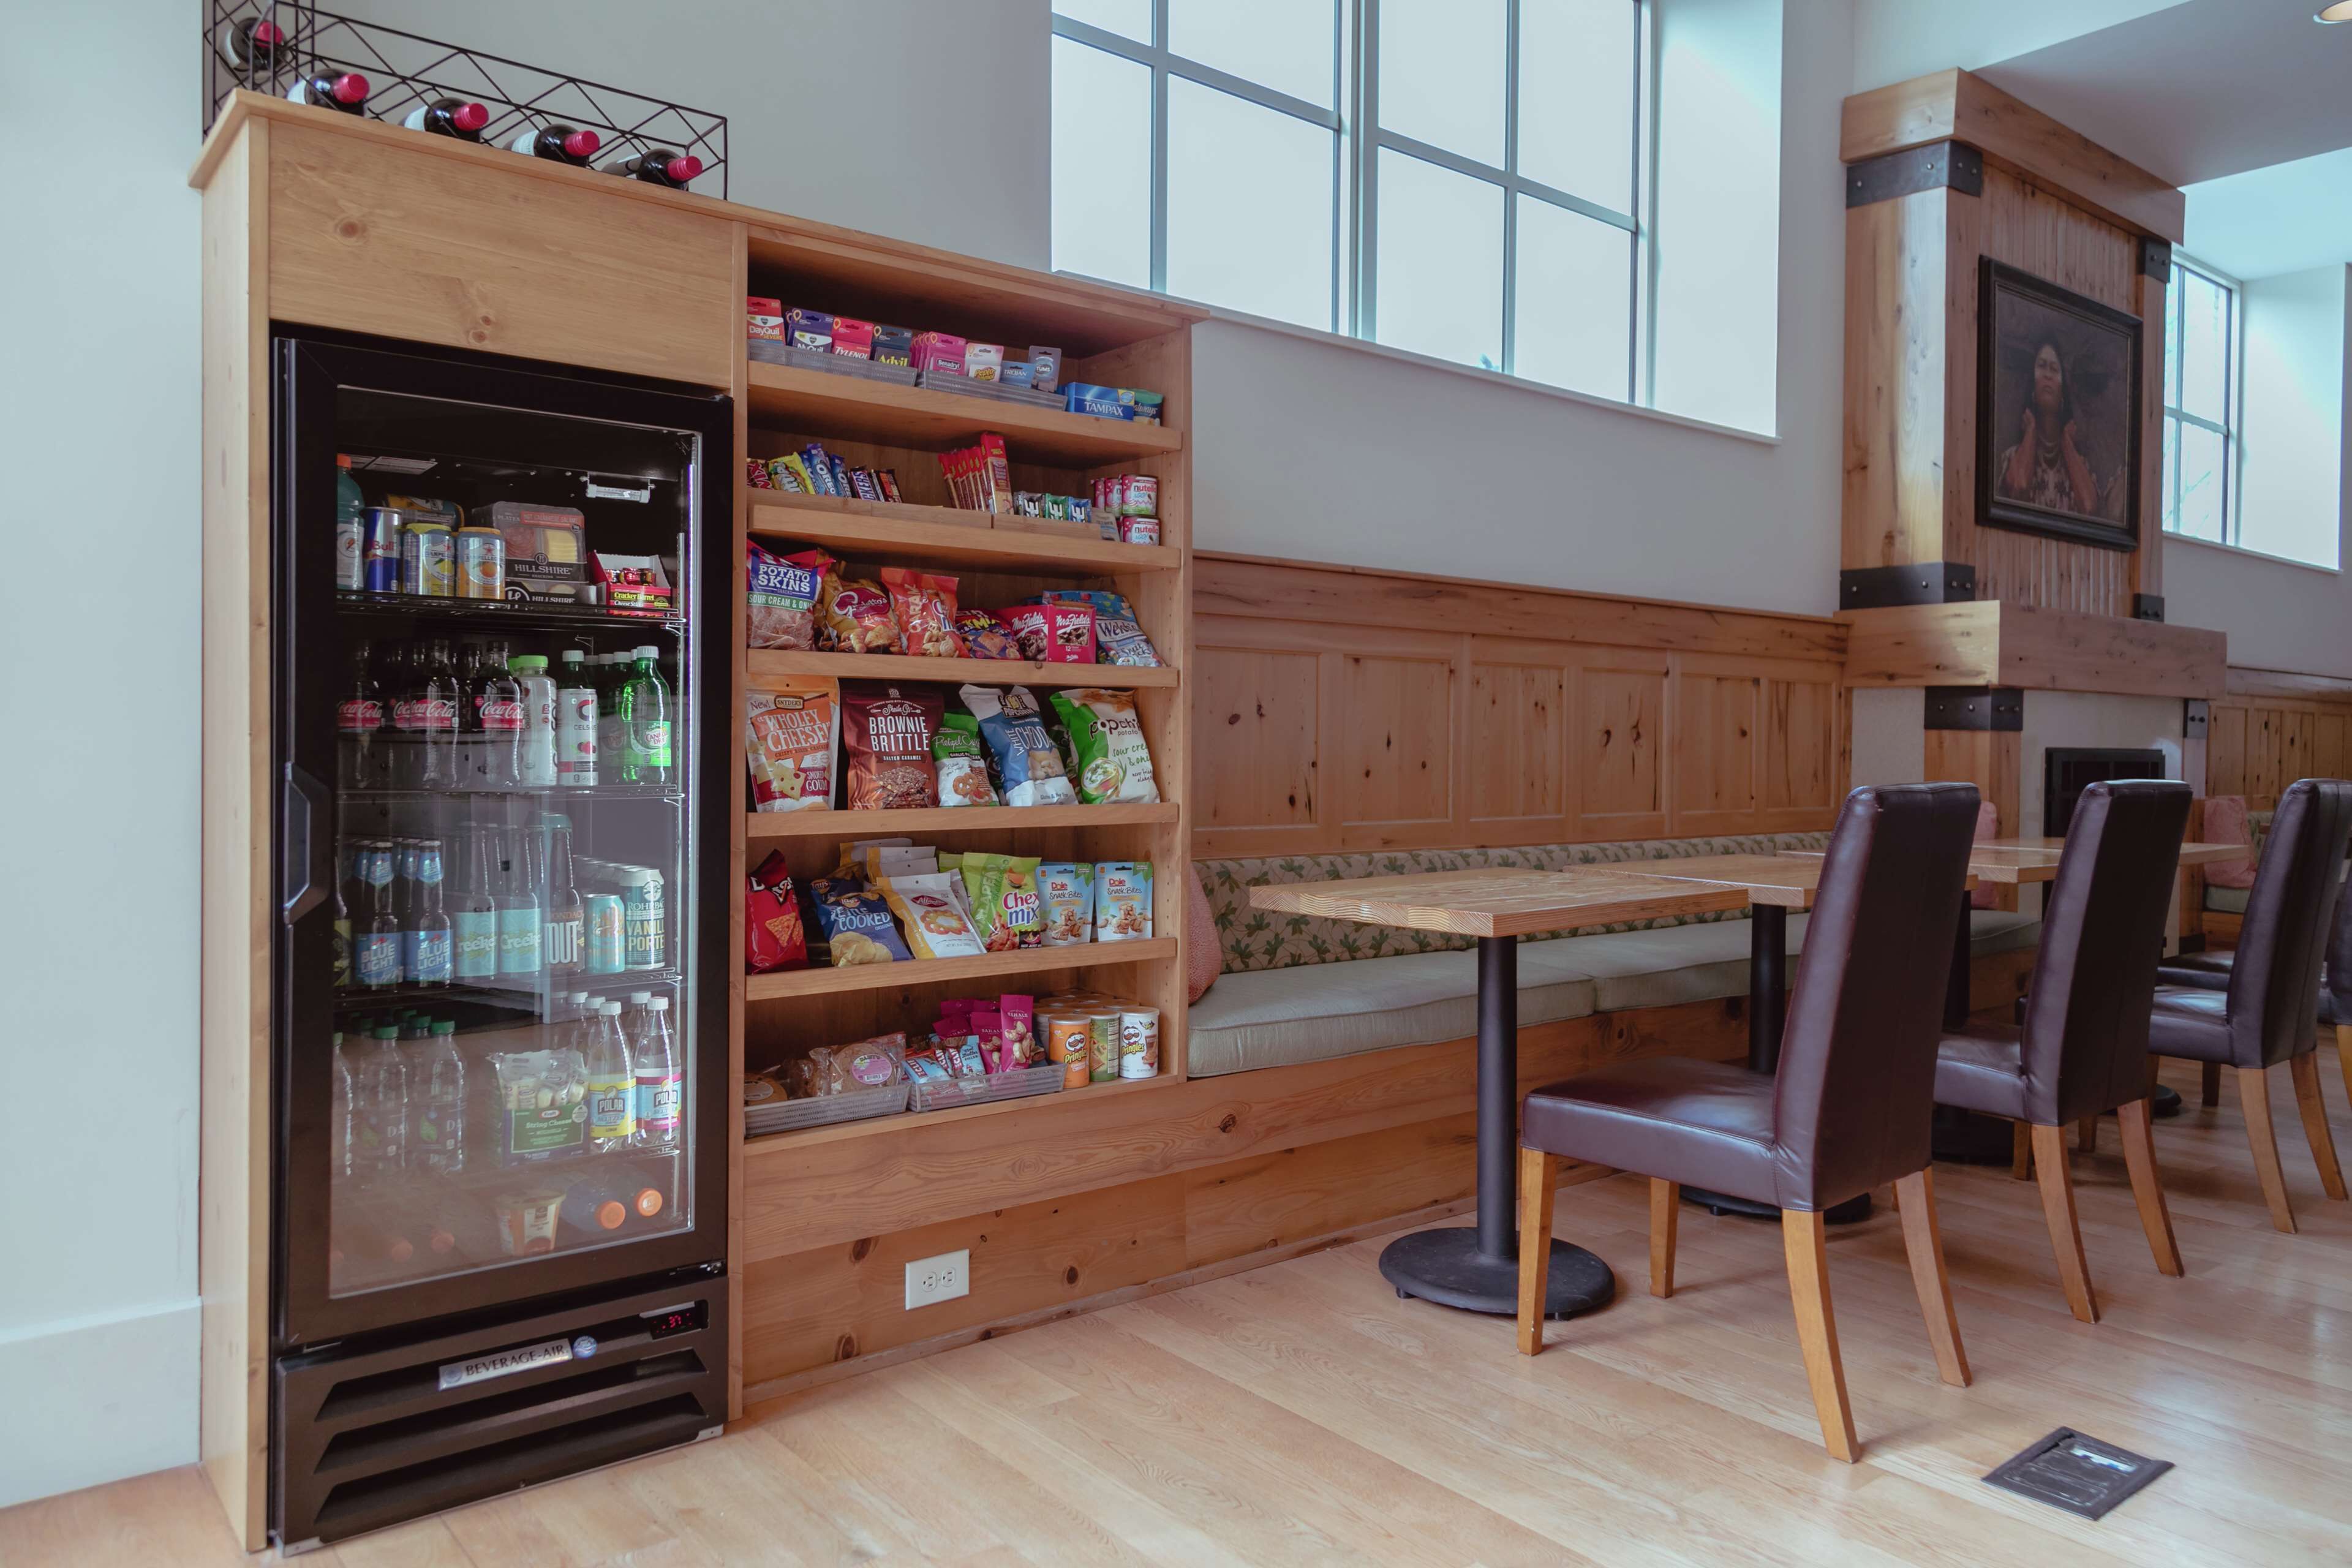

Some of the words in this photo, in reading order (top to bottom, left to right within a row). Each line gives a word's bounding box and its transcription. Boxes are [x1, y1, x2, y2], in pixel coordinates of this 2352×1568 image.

[749, 326, 780, 336] DayQuil
[835, 346, 869, 360] TYLENOL
[878, 355, 908, 366] Advil
[938, 359, 960, 369] Benadryl
[1084, 402, 1123, 417] TAMPAX
[815, 462, 837, 494] OREO
[837, 472, 853, 497] ORE
[852, 471, 876, 500] CKERS
[373, 540, 394, 551] Bull
[514, 564, 571, 575] HILLSHIRE
[759, 565, 810, 582] POTATO
[758, 574, 810, 592] SKINS
[748, 595, 766, 603] SOUR
[768, 597, 790, 607] CREAM
[799, 600, 812, 609] ONI
[750, 700, 771, 711] New!
[869, 716, 928, 734] BROWNIE
[871, 734, 930, 752] BRITTLE
[931, 735, 962, 750] Pretzel
[962, 735, 981, 748] Cris
[1005, 729, 1025, 756] WHITE
[1014, 726, 1052, 750] CHEDD
[1113, 747, 1130, 757] sour
[1131, 743, 1147, 752] cre
[1128, 756, 1135, 766] &
[1136, 753, 1150, 764] oni
[806, 779, 828, 791] GOU
[1003, 891, 1039, 910] Chex
[1049, 891, 1068, 900] Snack
[839, 912, 890, 930] COOKED
[1009, 905, 1039, 925] mix
[627, 919, 665, 935] VANILL
[418, 941, 450, 959] BLUE
[628, 935, 665, 951] PORTE
[361, 944, 395, 962] BLUE
[361, 956, 395, 973] LIGHT
[417, 953, 450, 970] LIGHT
[1121, 1042, 1144, 1058] Pringles
[598, 1099, 624, 1112] POLAR
[655, 1091, 677, 1105] POLR
[669, 1314, 682, 1329] 37
[466, 1344, 564, 1376] BEVERAGE-AIR
